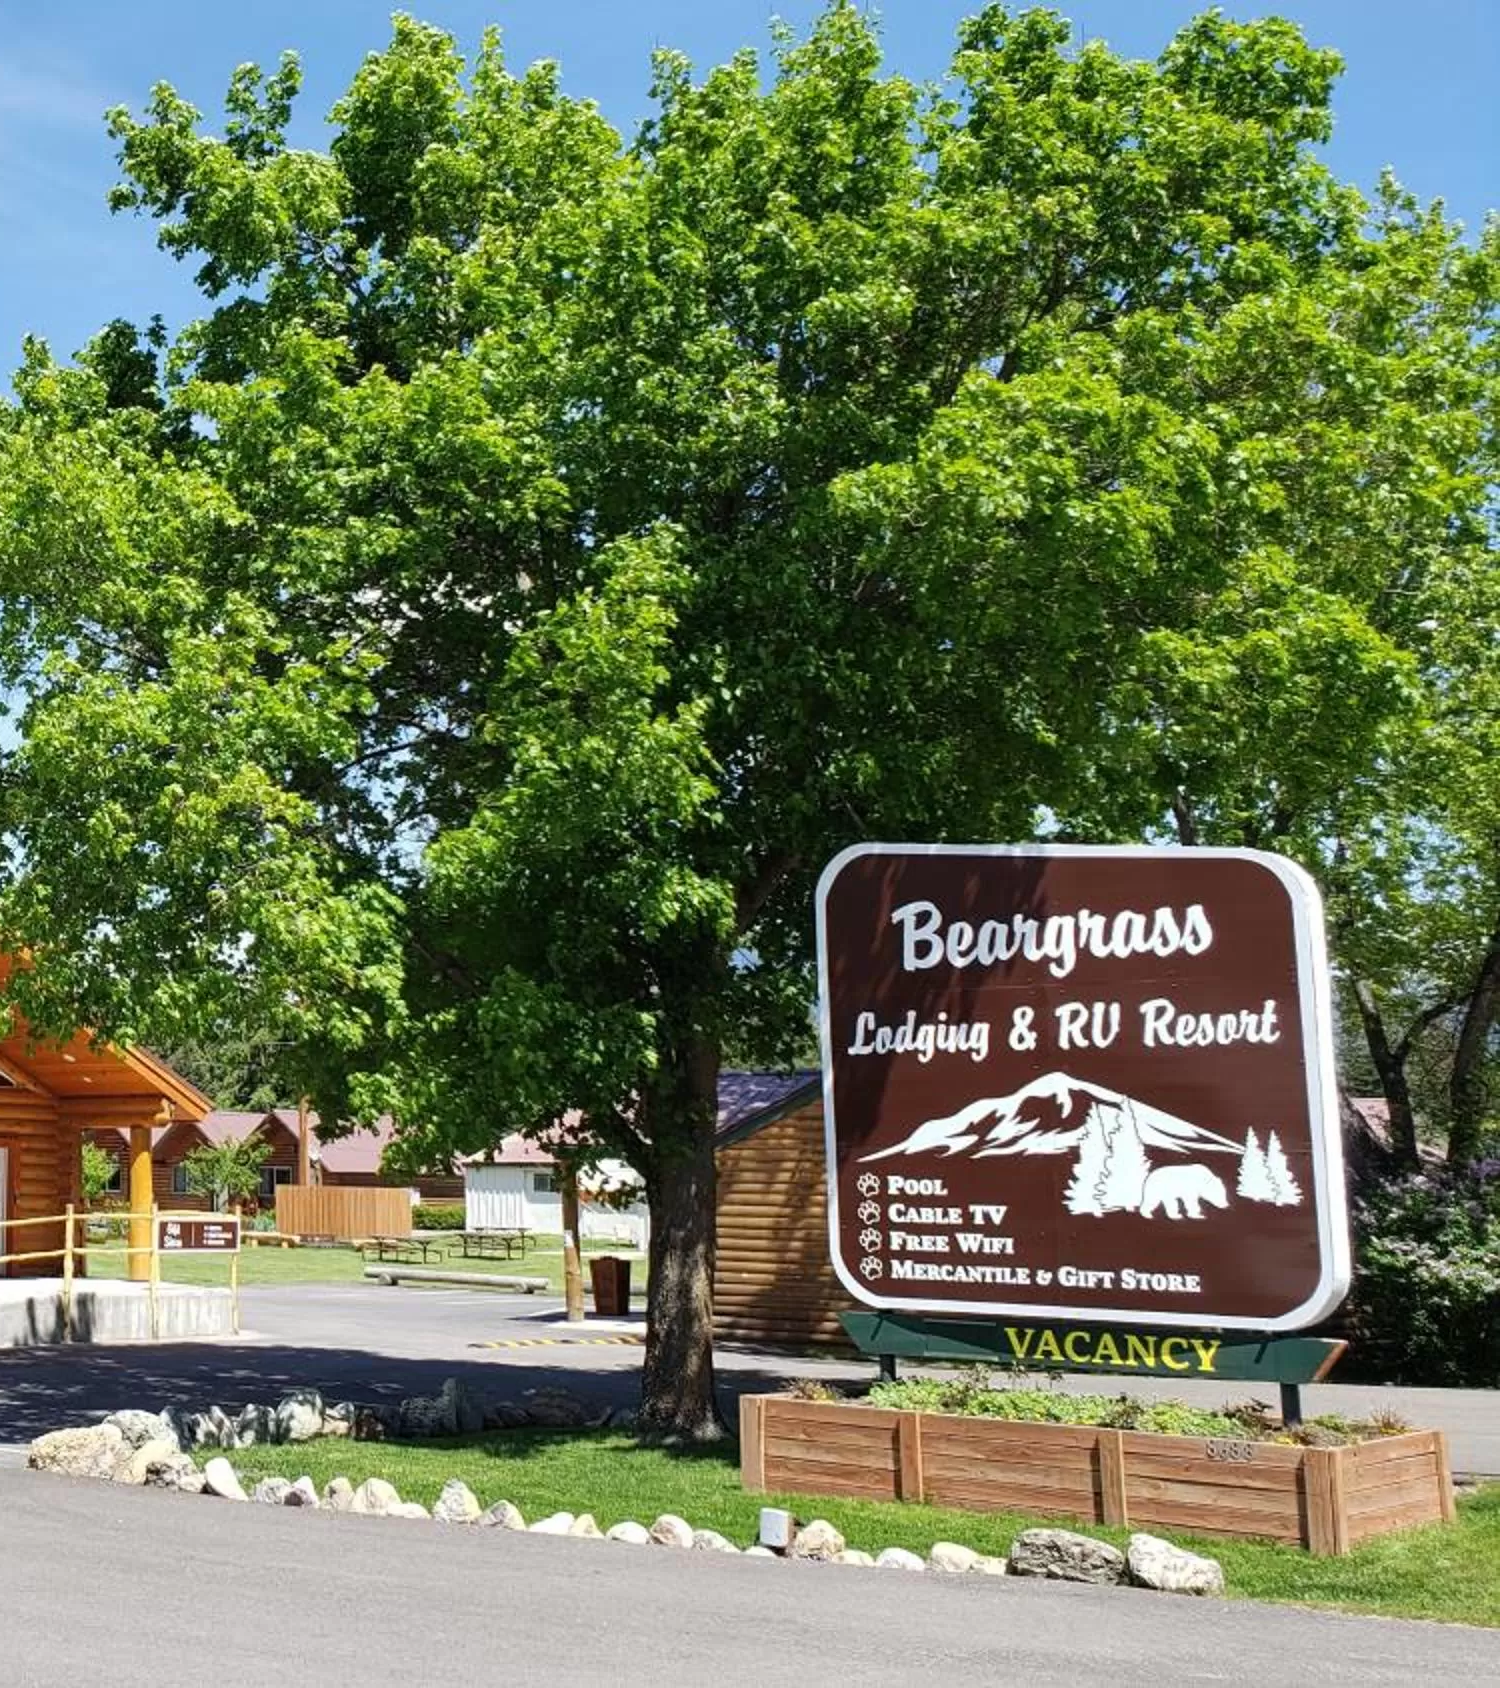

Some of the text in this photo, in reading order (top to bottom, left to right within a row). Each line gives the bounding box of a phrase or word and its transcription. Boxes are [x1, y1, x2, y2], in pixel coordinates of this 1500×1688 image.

[891, 900, 1214, 978] Beargrass
[848, 998, 1281, 1063] Lodging & RV Resort
[887, 1175, 948, 1196] POOL
[888, 1204, 1008, 1226] CABLE TV
[889, 1231, 950, 1253] FREE
[890, 1259, 1202, 1293] MERCANTILE & GIFT STORE
[1003, 1327, 1223, 1373] VACANCY
